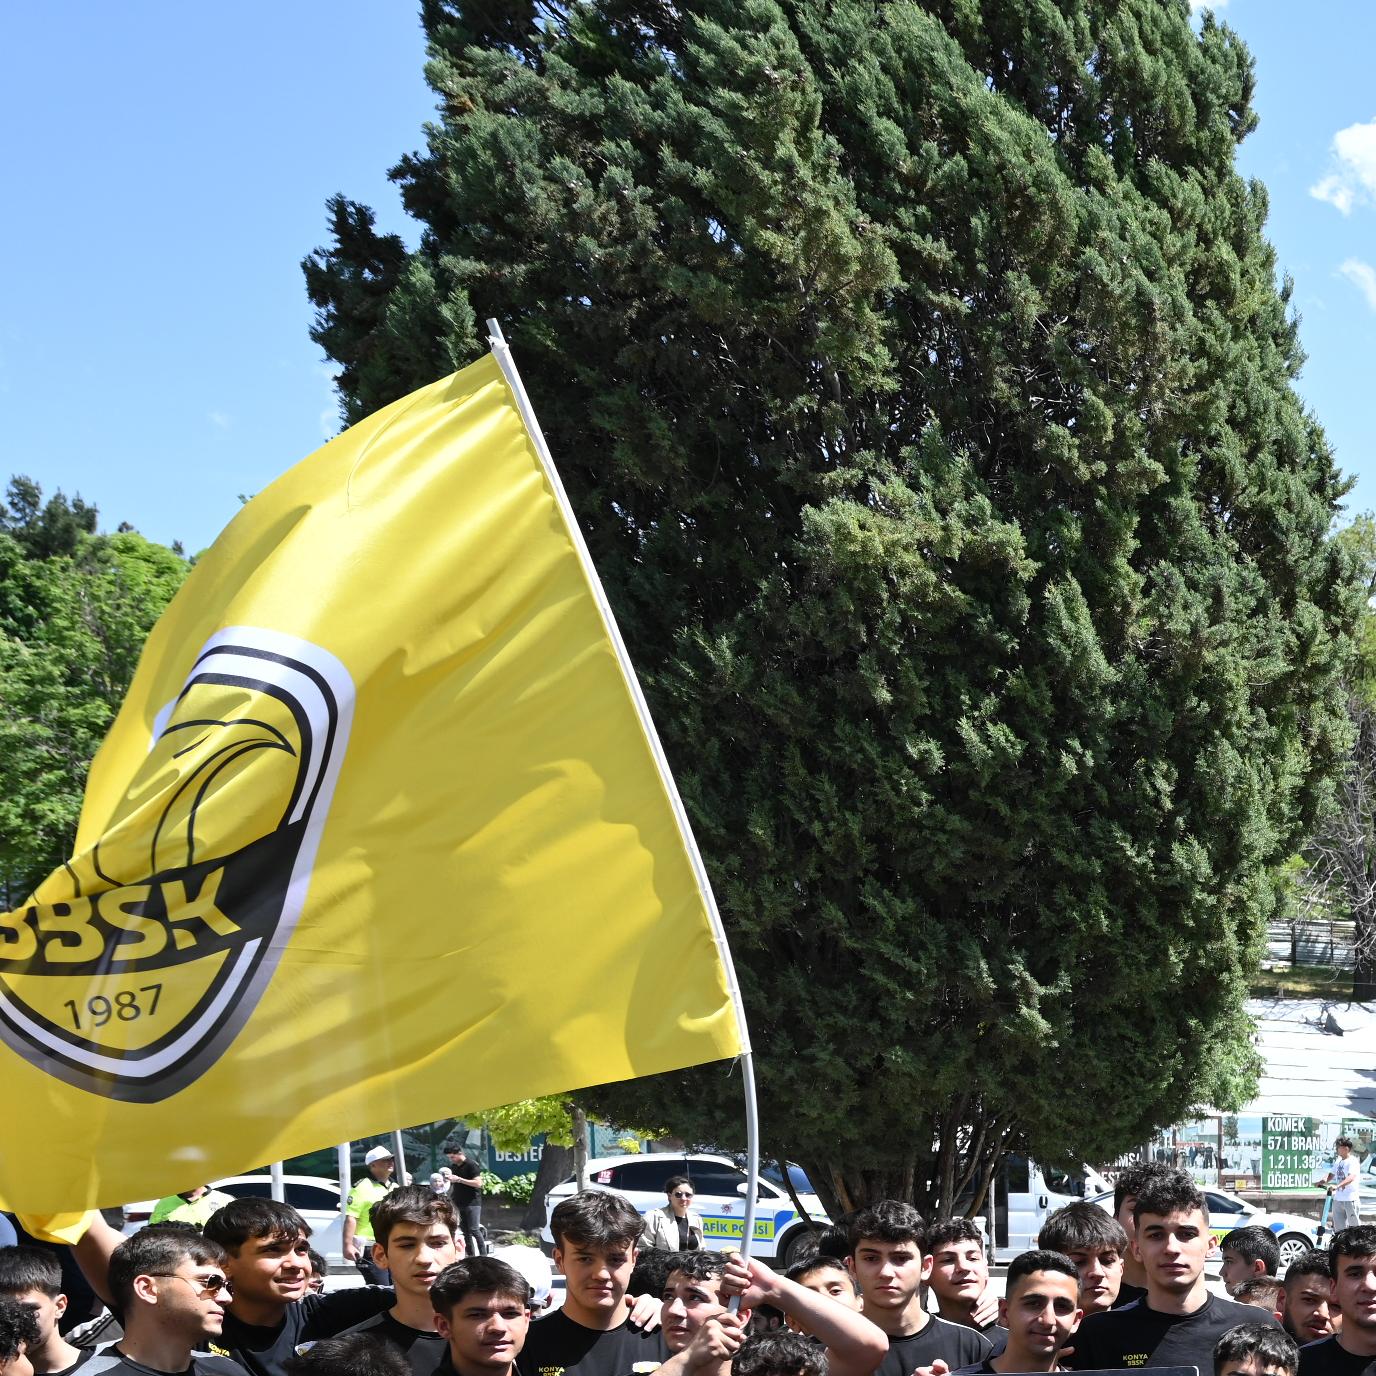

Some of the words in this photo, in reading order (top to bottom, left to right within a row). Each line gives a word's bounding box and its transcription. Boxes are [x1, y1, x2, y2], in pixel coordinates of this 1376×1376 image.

[64, 984, 162, 1030] 1987
[1268, 1136, 1288, 1151] 571
[1267, 1171, 1313, 1188] ÖĞRENCİ
[703, 1220, 728, 1233] AFİK
[1122, 1353, 1149, 1361] KONYA
